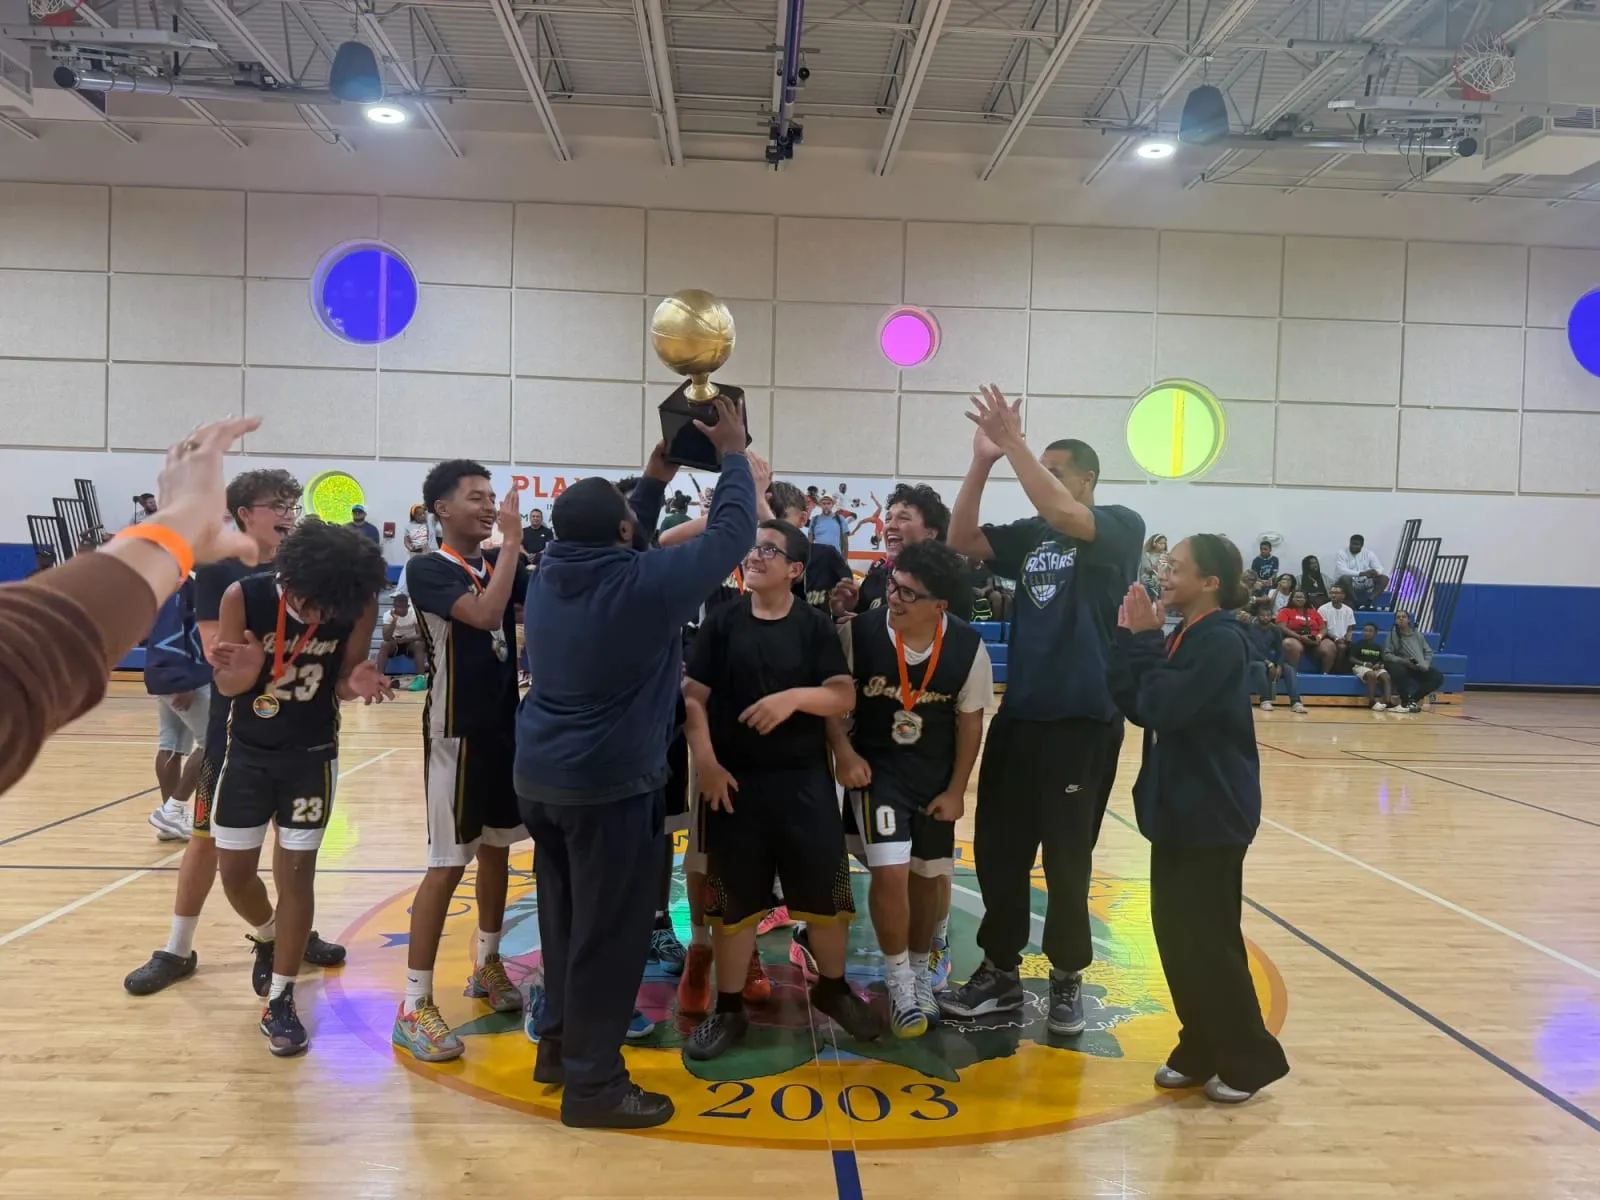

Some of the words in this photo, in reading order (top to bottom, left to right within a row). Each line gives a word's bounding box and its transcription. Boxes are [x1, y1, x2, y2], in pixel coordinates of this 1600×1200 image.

[511, 475, 583, 498] PLA
[264, 663, 324, 701] 23
[292, 797, 323, 822] 23
[876, 805, 896, 836] 0
[697, 1081, 959, 1122] 2003
